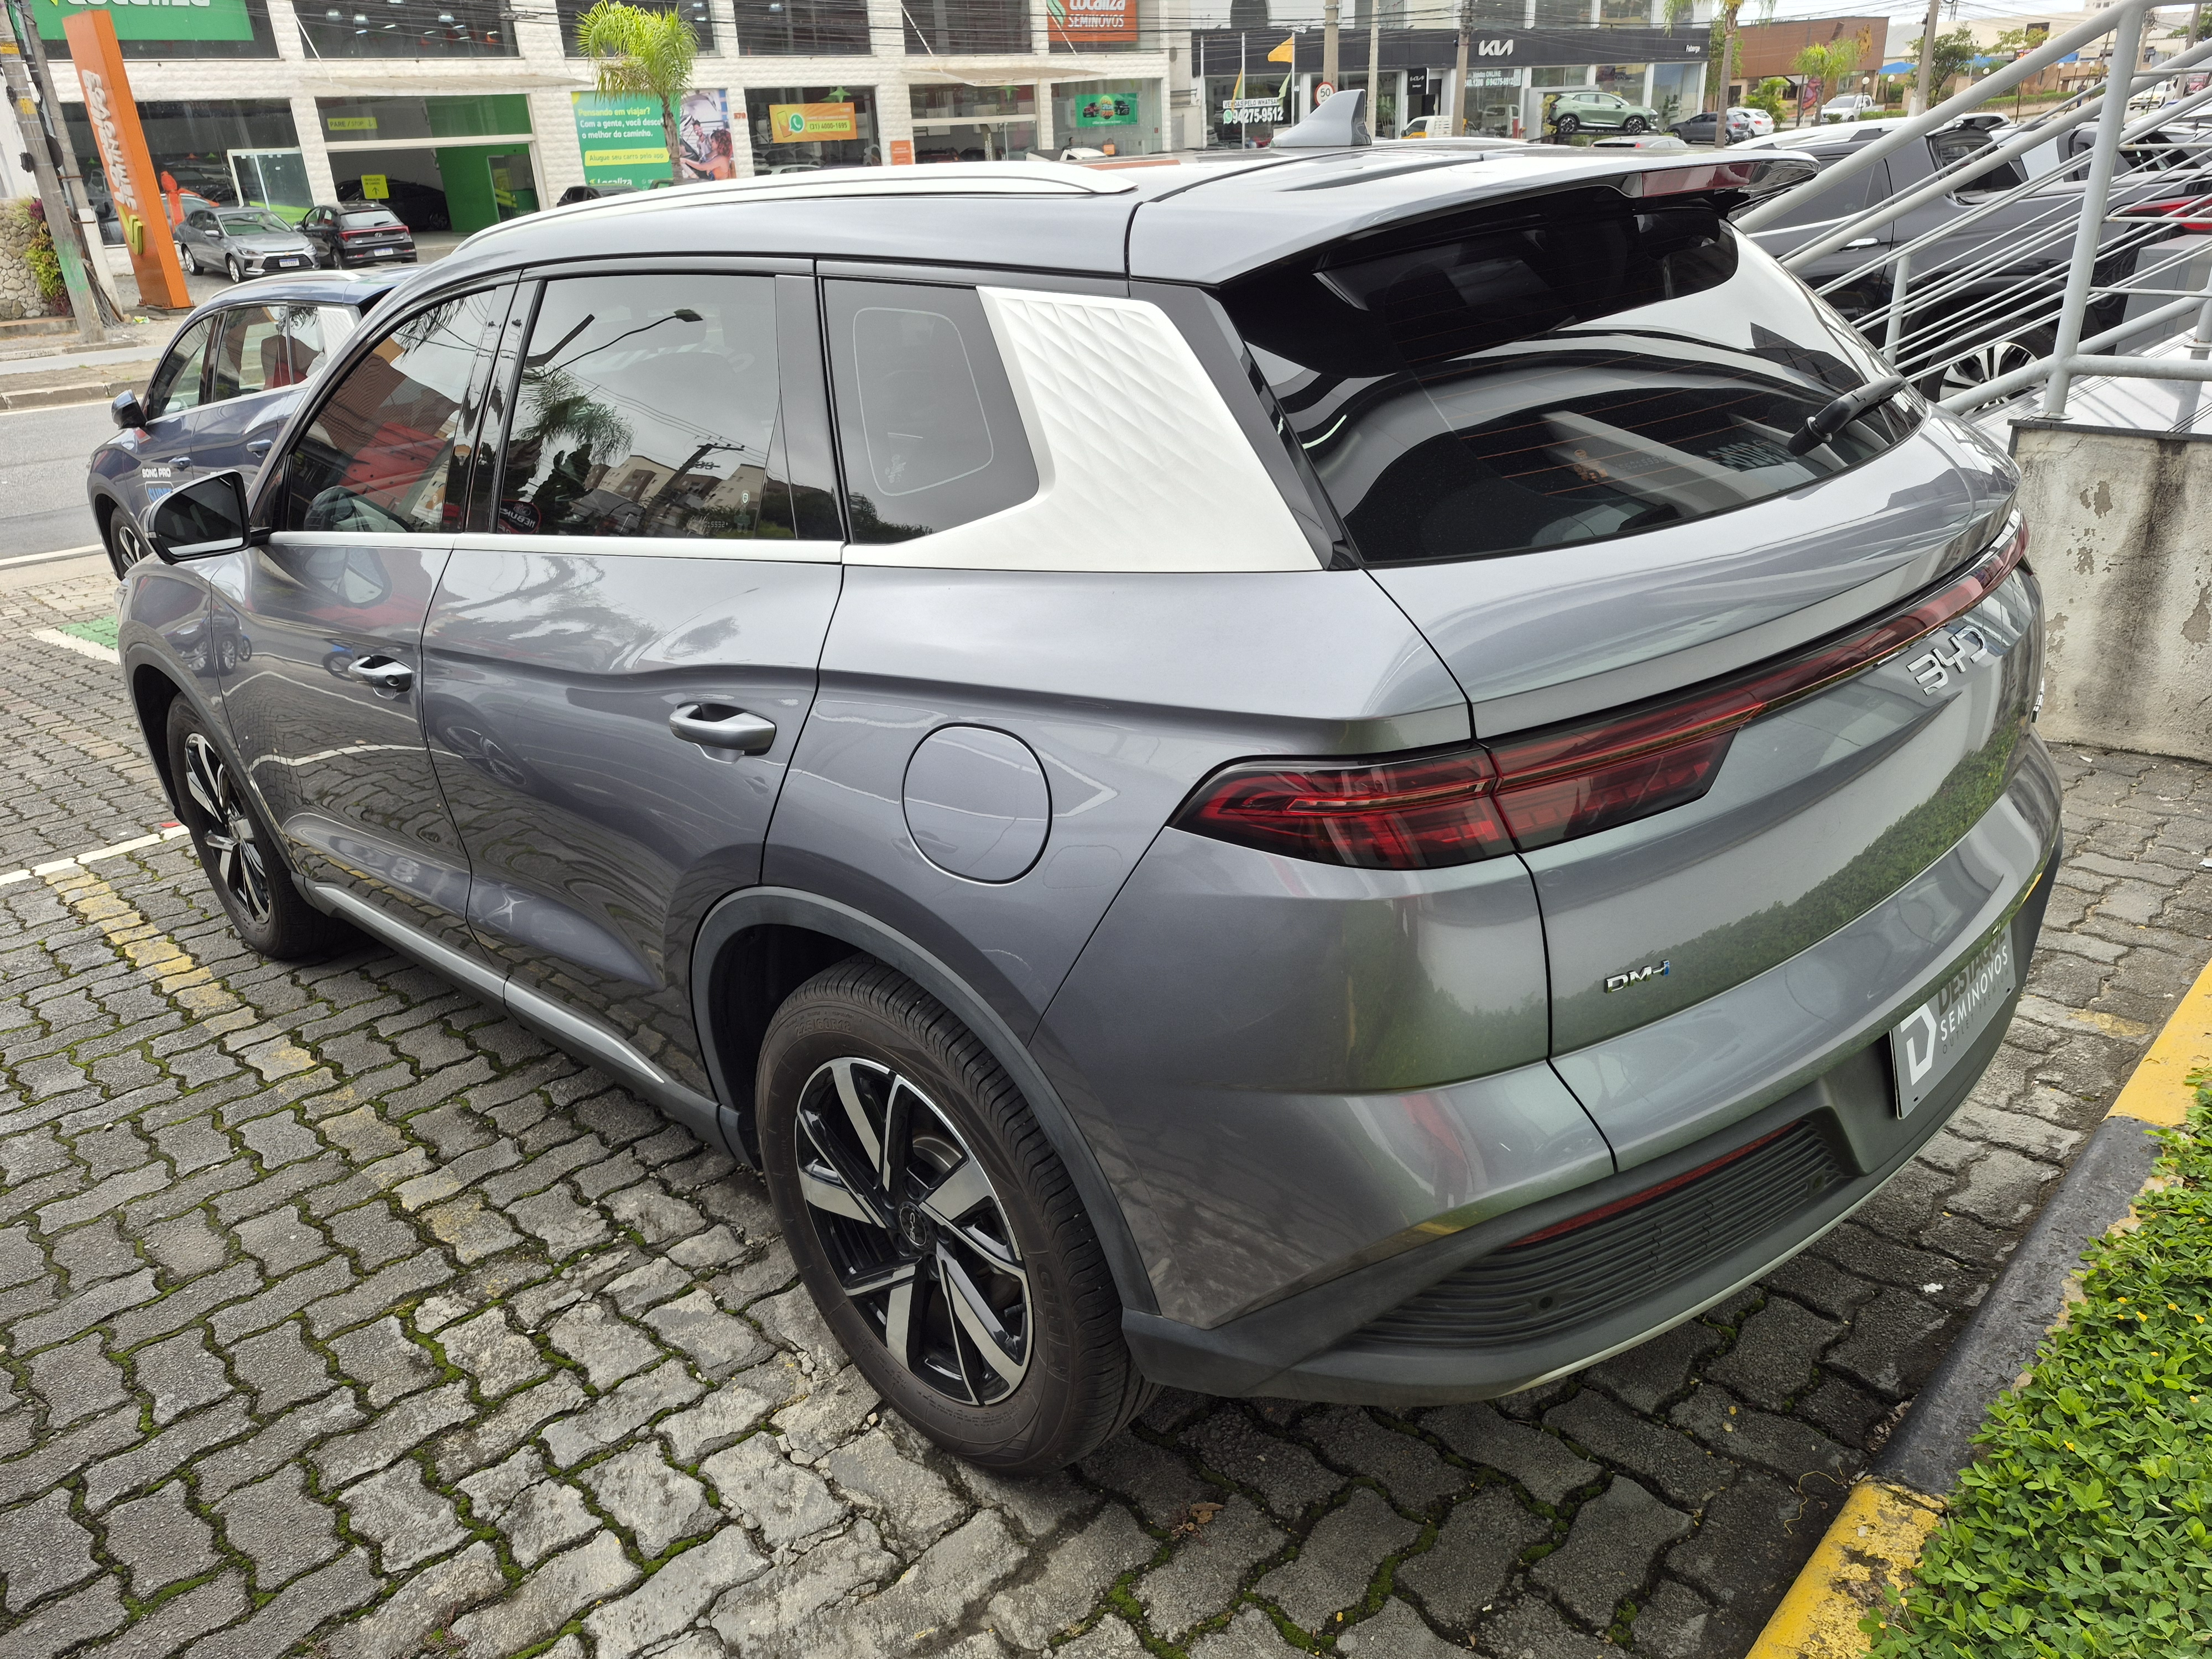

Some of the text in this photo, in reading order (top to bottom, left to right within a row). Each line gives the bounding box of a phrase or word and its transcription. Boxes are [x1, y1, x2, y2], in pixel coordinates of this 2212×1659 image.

[1068, 14, 1124, 27] SEMINOVOS
[1478, 39, 1514, 56] KIA
[1321, 88, 1331, 97] 50
[1224, 100, 1243, 108] VEDAS
[578, 108, 613, 117] Pensando
[627, 107, 650, 117] viajar?
[1232, 106, 1284, 124] 94275-9512
[580, 120, 596, 128] Com
[603, 119, 625, 129] gente,
[625, 118, 641, 127] você
[588, 131, 612, 139] melhor
[613, 130, 622, 138] do
[623, 129, 653, 138] caminho.
[142, 468, 171, 478] SONG PRO
[1940, 945, 2008, 1041] SEMINOVOS
[1943, 968, 2008, 1055] OUTLET PREMIUM
